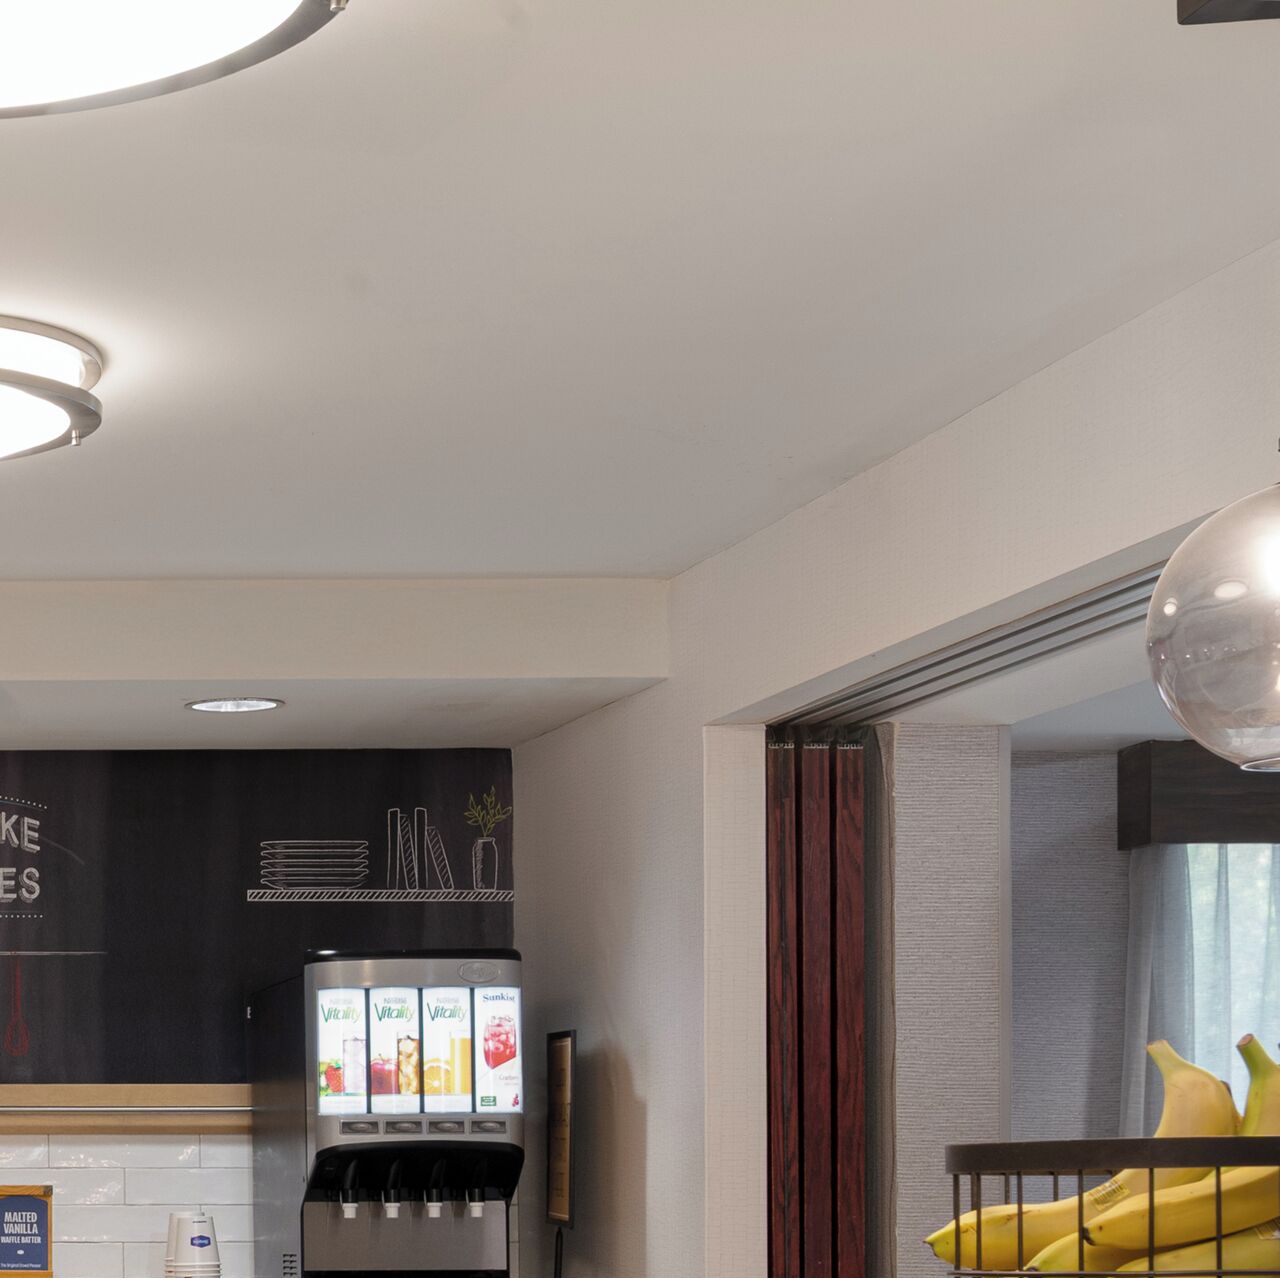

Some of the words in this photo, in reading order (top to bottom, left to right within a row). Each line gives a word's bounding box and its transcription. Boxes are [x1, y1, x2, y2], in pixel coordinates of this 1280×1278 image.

[482, 993, 515, 1003] Sunkist
[321, 1003, 362, 1023] Vitality
[374, 1002, 416, 1022] Vitality
[427, 1002, 467, 1022] Vitality
[4, 1212, 38, 1223] MALTED
[3, 1223, 38, 1234] VANILLA
[0, 1236, 21, 1244] WAFFLE
[21, 1236, 42, 1244] BATTER
